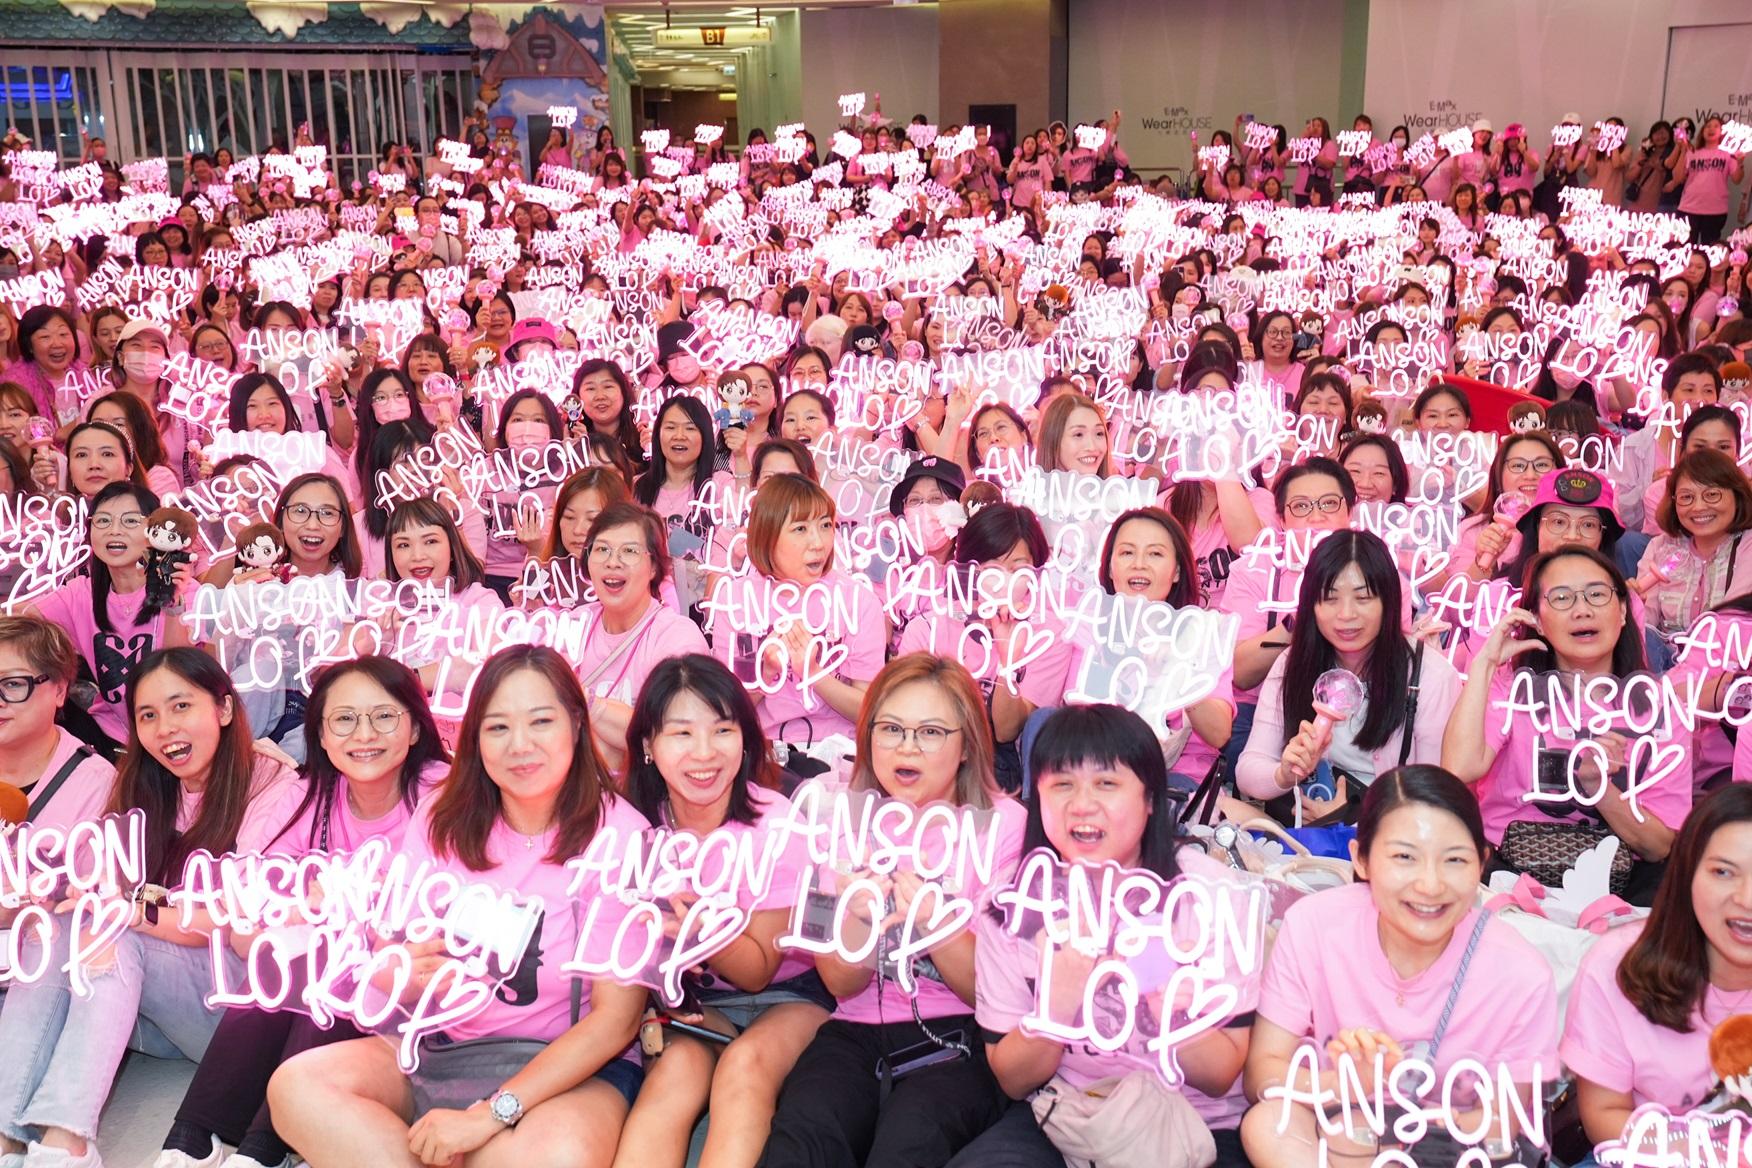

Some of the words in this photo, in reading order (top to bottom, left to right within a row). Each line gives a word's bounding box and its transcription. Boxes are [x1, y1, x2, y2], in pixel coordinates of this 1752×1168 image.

[705, 28, 721, 43] B1
[1142, 117, 1212, 129] WearHOUSE
[130, 266, 199, 293] ANSON
[525, 265, 584, 288] ANSON
[930, 295, 1005, 321] ANSON
[1199, 274, 1260, 299] ANSON
[933, 344, 1046, 387] ANSON
[374, 415, 484, 516] ANSON
[697, 574, 860, 638] ANSON
[1062, 587, 1240, 668] ANSON
[1493, 670, 1698, 738] ANSON
[565, 826, 778, 899] ANSON
[769, 785, 1002, 891] ANSON
[997, 852, 1261, 976] ANSON
[1263, 1044, 1547, 1151] ANSON
